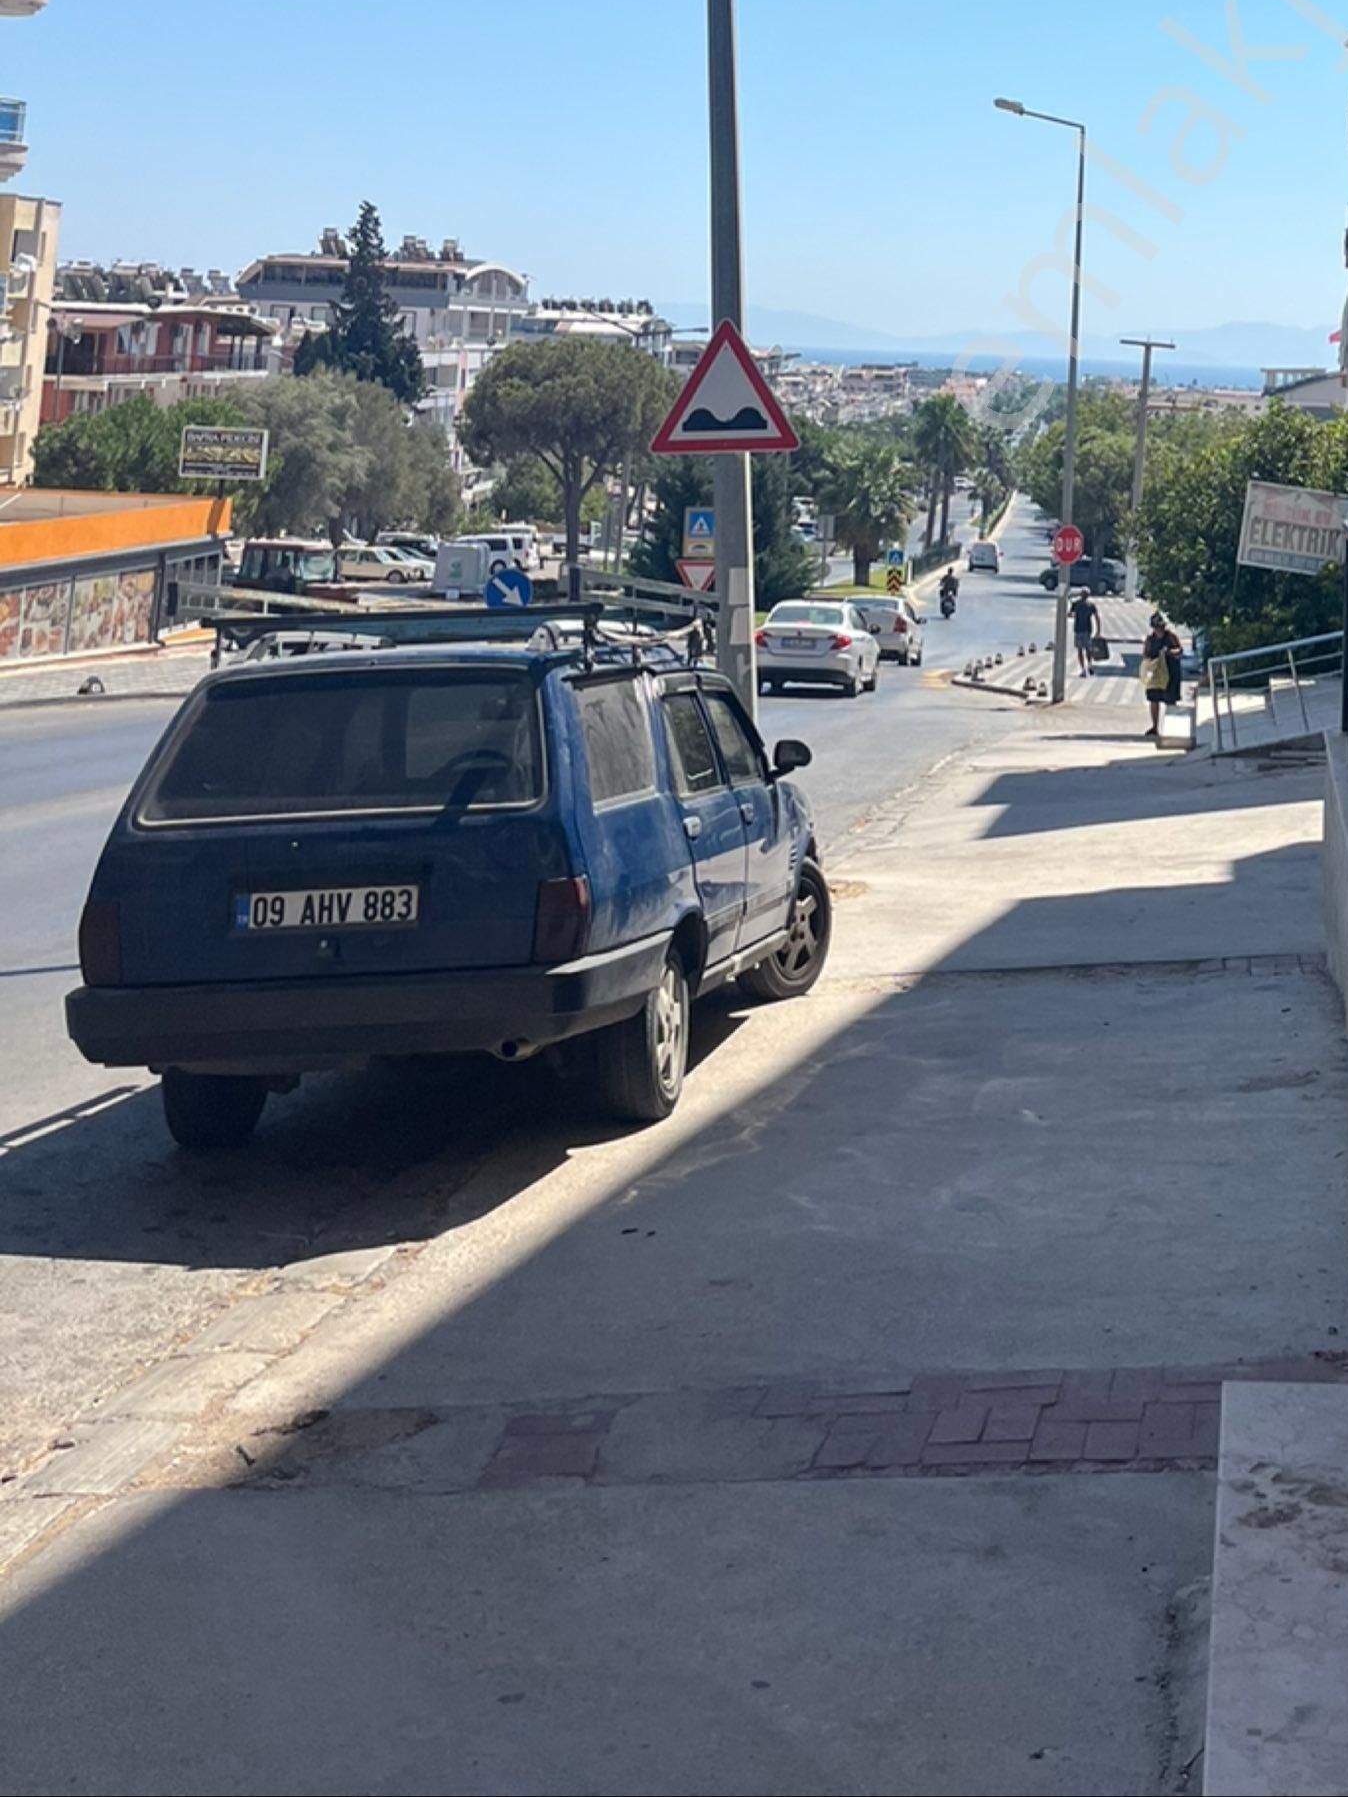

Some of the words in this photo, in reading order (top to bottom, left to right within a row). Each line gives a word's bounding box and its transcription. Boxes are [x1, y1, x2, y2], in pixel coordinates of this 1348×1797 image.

[1056, 536, 1082, 553] DUR
[253, 896, 285, 927] 09
[301, 892, 352, 925] AHV
[363, 889, 413, 922] 883
